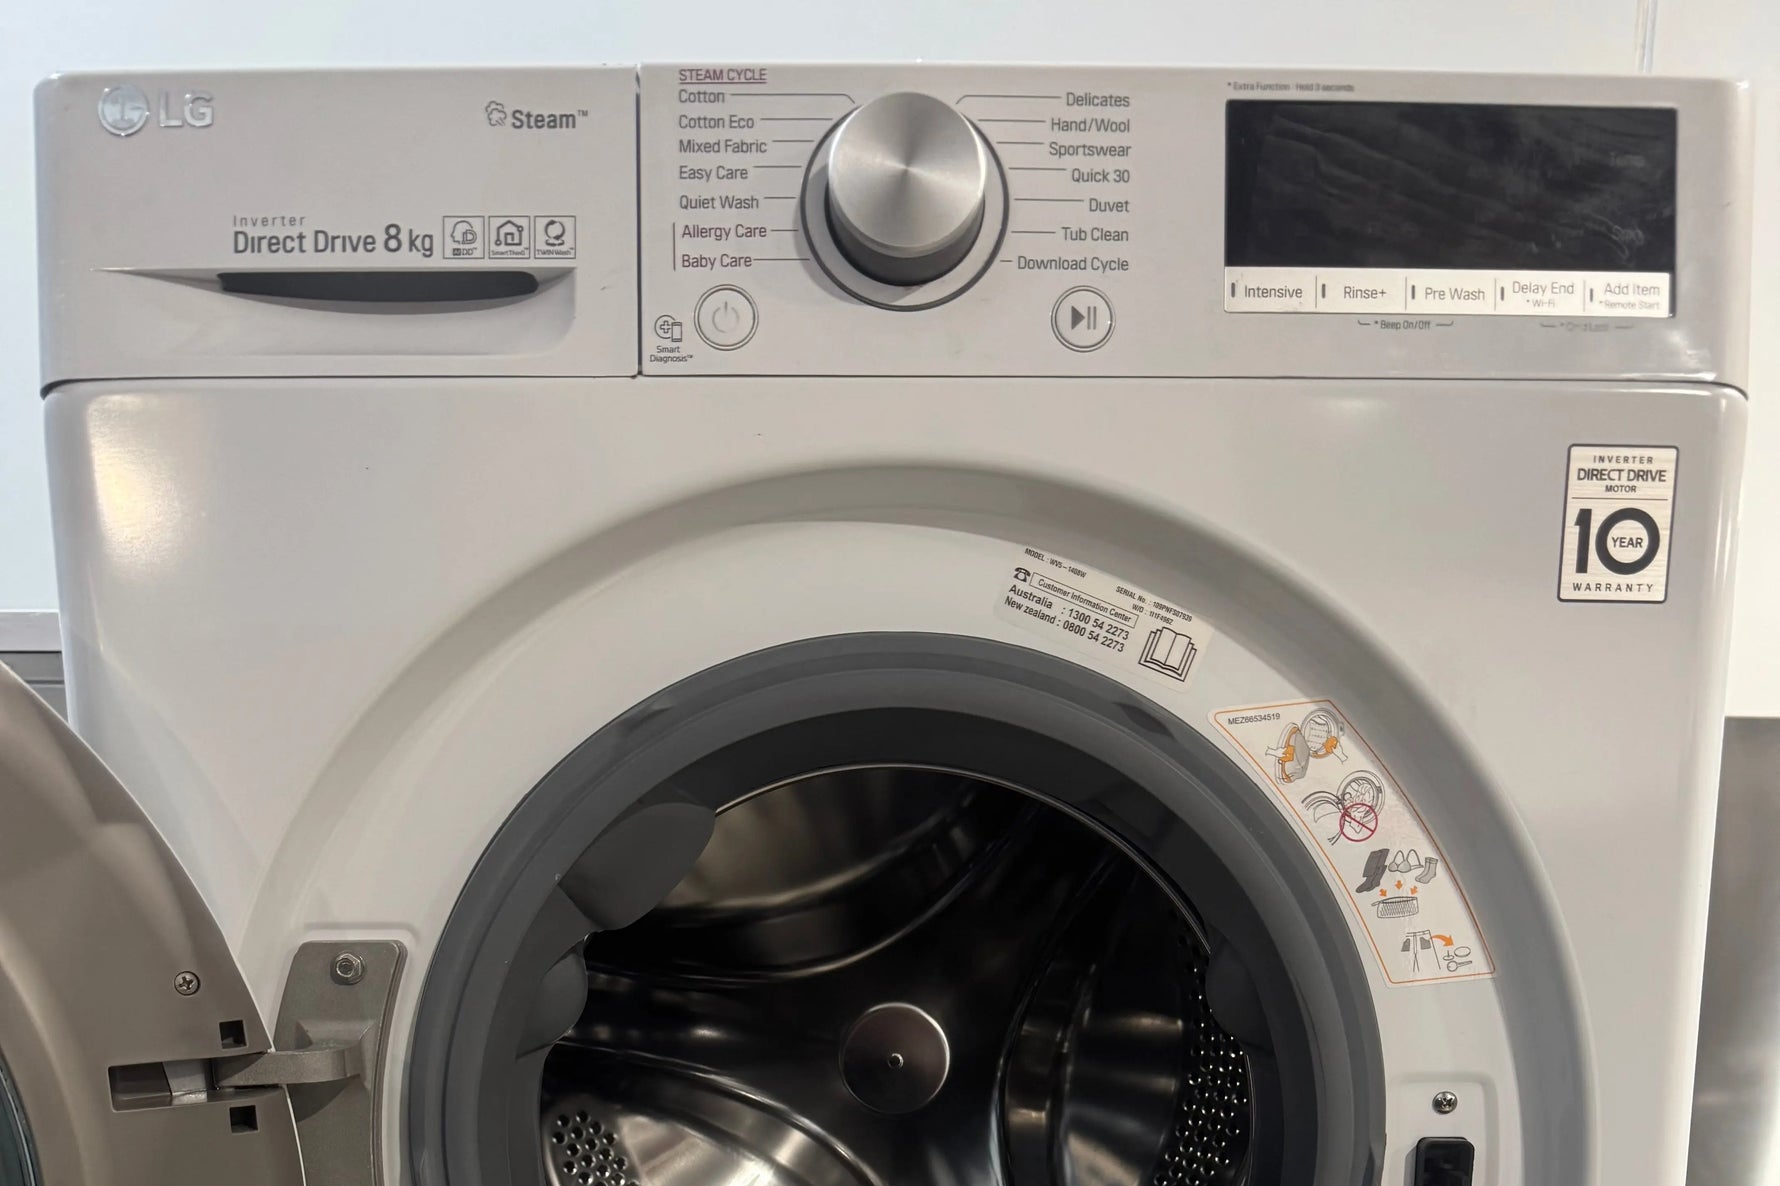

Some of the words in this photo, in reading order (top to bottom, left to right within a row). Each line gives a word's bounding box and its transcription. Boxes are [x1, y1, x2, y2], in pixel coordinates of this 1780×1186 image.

[679, 68, 724, 81] STEAM
[727, 68, 767, 81] CYCLE
[679, 89, 725, 103] Cotton
[1066, 92, 1130, 107] Delicates
[158, 90, 215, 128] LG
[679, 114, 725, 129] Cotton
[729, 115, 754, 129] Eco
[1051, 118, 1130, 132] Hand/Wool
[679, 139, 720, 153] Mixed
[724, 139, 767, 153] Fabric
[1049, 141, 1132, 159] Sportswear
[679, 165, 712, 182] Easy
[716, 165, 748, 180] Care
[1072, 168, 1110, 183] Quick
[1113, 169, 1130, 183] 30
[679, 195, 716, 210] Quiet
[719, 195, 759, 209] Wash
[1089, 198, 1130, 213] Duvet
[233, 215, 306, 227] Inverter
[682, 224, 731, 241] Allergy
[735, 224, 767, 238] Care
[1061, 226, 1087, 241] Tub
[1091, 227, 1129, 241] Clean
[233, 230, 306, 253] Direct
[313, 229, 376, 253] Drive
[383, 223, 402, 253] 8
[408, 228, 434, 258] kg
[682, 254, 716, 271] Baby
[720, 253, 752, 267] Care
[1018, 256, 1087, 270] Download
[1091, 257, 1129, 273] Cycle
[1244, 285, 1303, 299] Intensive
[1344, 286, 1387, 299] Rinse+
[1425, 287, 1446, 300] Pre
[1449, 287, 1486, 300] Wash
[1512, 281, 1547, 295] Delay
[1551, 281, 1575, 295] End
[1604, 283, 1629, 296] Add
[1632, 283, 1660, 296] Item
[1381, 320, 1401, 330] Beep
[656, 345, 680, 353] Smart
[1593, 456, 1654, 464] INVERTER
[1577, 468, 1624, 481] DIRECT
[1627, 469, 1667, 482] DRIVE
[1605, 484, 1637, 493] MOTOR
[1574, 507, 1660, 575] 10
[1611, 537, 1644, 548] YEAR
[1572, 582, 1654, 592] WARRANTY
[1038, 578, 1073, 597] Customer
[1071, 591, 1108, 613] Information
[1109, 608, 1131, 622] Center
[1009, 584, 1053, 609] Australia
[1068, 608, 1091, 625] 1300
[1091, 618, 1104, 630] 54
[1105, 623, 1130, 640] 2273
[1004, 595, 1023, 611] New
[1023, 604, 1056, 624] zealand
[1062, 620, 1086, 637] 0800
[1087, 630, 1100, 642] 54
[1100, 636, 1125, 652] 2273
